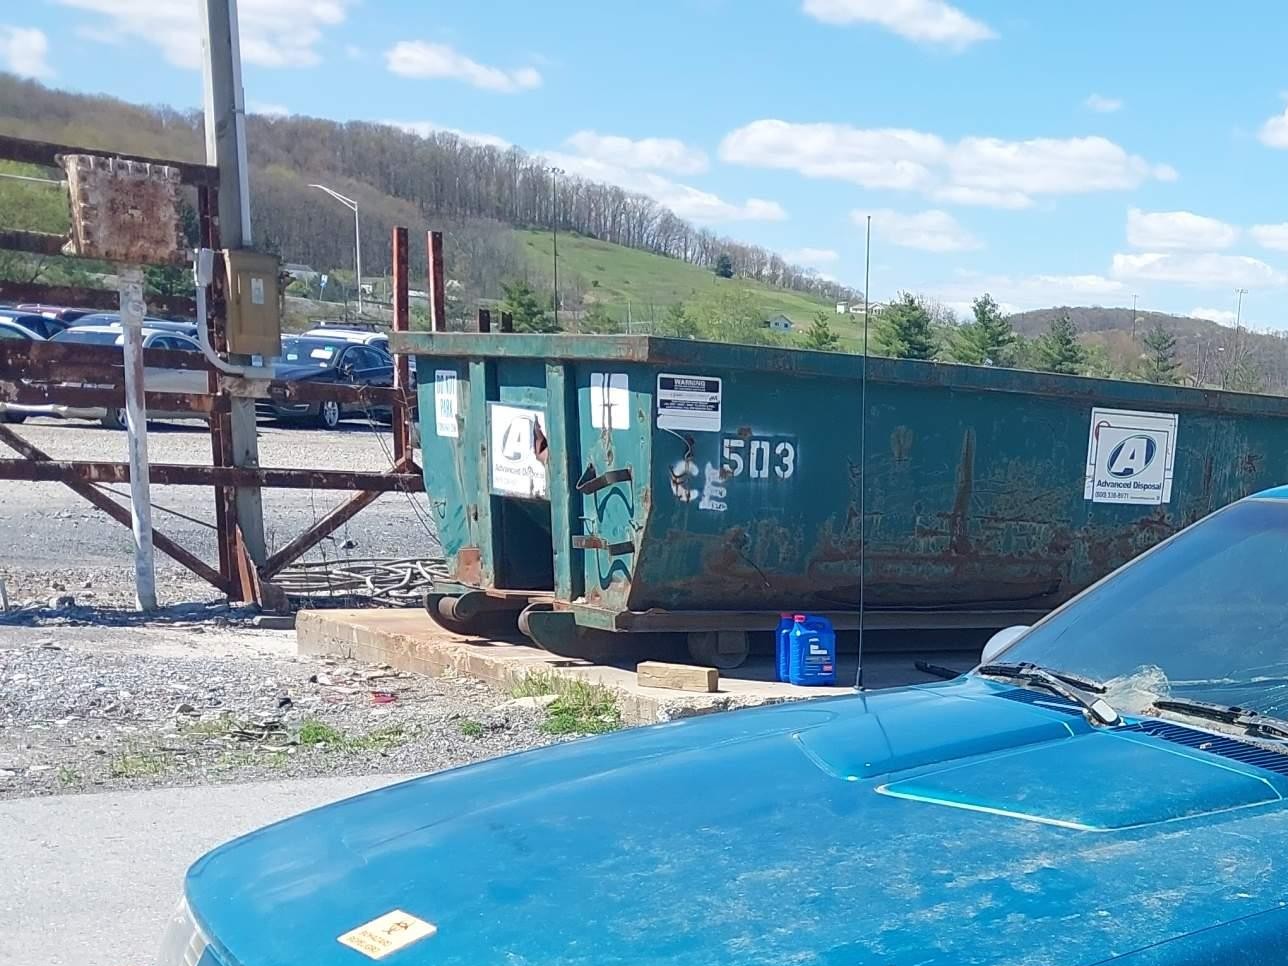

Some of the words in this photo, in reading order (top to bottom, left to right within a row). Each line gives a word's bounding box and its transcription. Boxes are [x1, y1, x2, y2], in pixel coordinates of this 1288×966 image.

[674, 378, 706, 386] WARNING
[723, 439, 795, 479] 503
[1096, 480, 1132, 489] Advanced
[1133, 481, 1162, 491] Disposal
